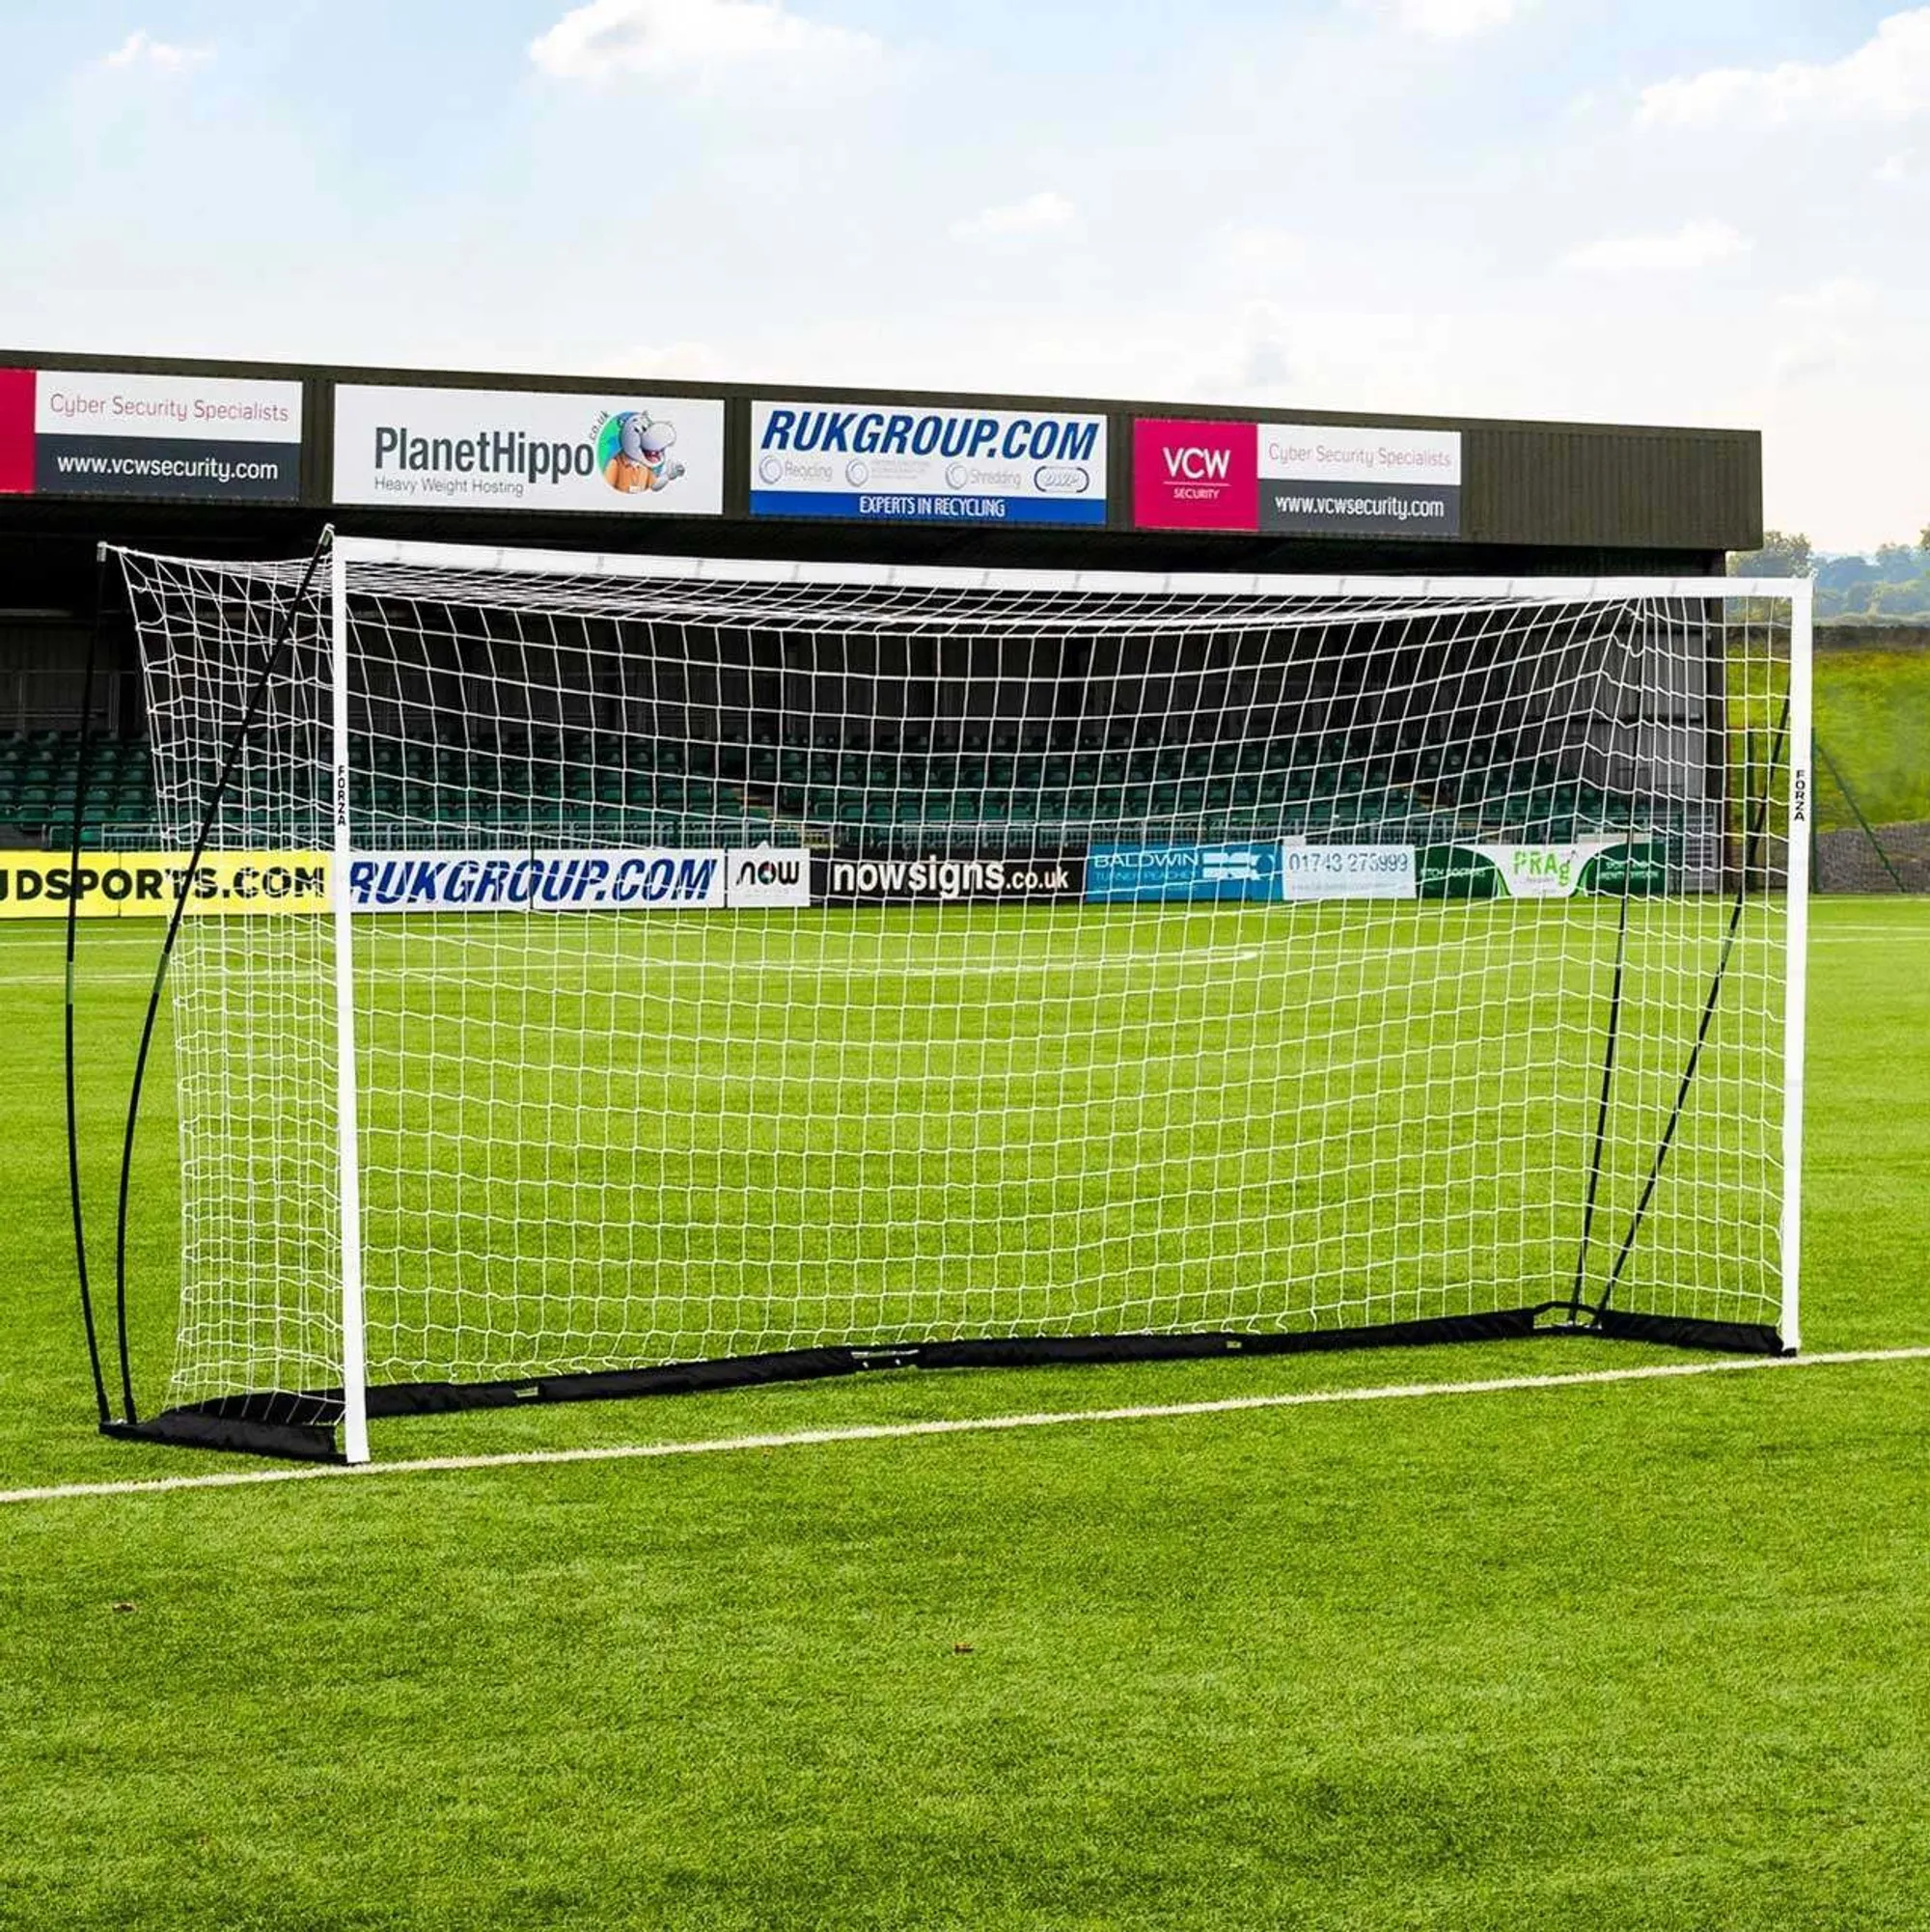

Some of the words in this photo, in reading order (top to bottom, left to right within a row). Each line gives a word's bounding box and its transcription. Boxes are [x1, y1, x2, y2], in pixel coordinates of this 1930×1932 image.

[50, 393, 106, 416] Cyber
[112, 396, 187, 422] Security
[193, 400, 290, 423] Specialists
[760, 409, 1100, 461] RUKGROUP.COM
[57, 455, 279, 483] www.vcwsecurity.com
[374, 427, 594, 484] PlanetHippo
[1163, 447, 1231, 480] VCW
[1269, 443, 1312, 464] Cyber
[1316, 445, 1374, 468] Security
[1378, 447, 1452, 467] Specialists
[374, 476, 417, 495] Heavy
[421, 478, 468, 495] Weight
[472, 479, 524, 498] Hosting
[859, 495, 916, 515] EXPERTS
[917, 497, 932, 515] IN
[934, 497, 1006, 517] RECYCLING
[1275, 494, 1445, 521] www.vcwsecurity.com
[338, 764, 346, 826] FORZA
[1794, 769, 1806, 822] FORZA
[1093, 852, 1199, 869] BALDWIN
[350, 858, 718, 903] RUKGROUP.COM
[832, 855, 1069, 900] nowsigns.co.uk
